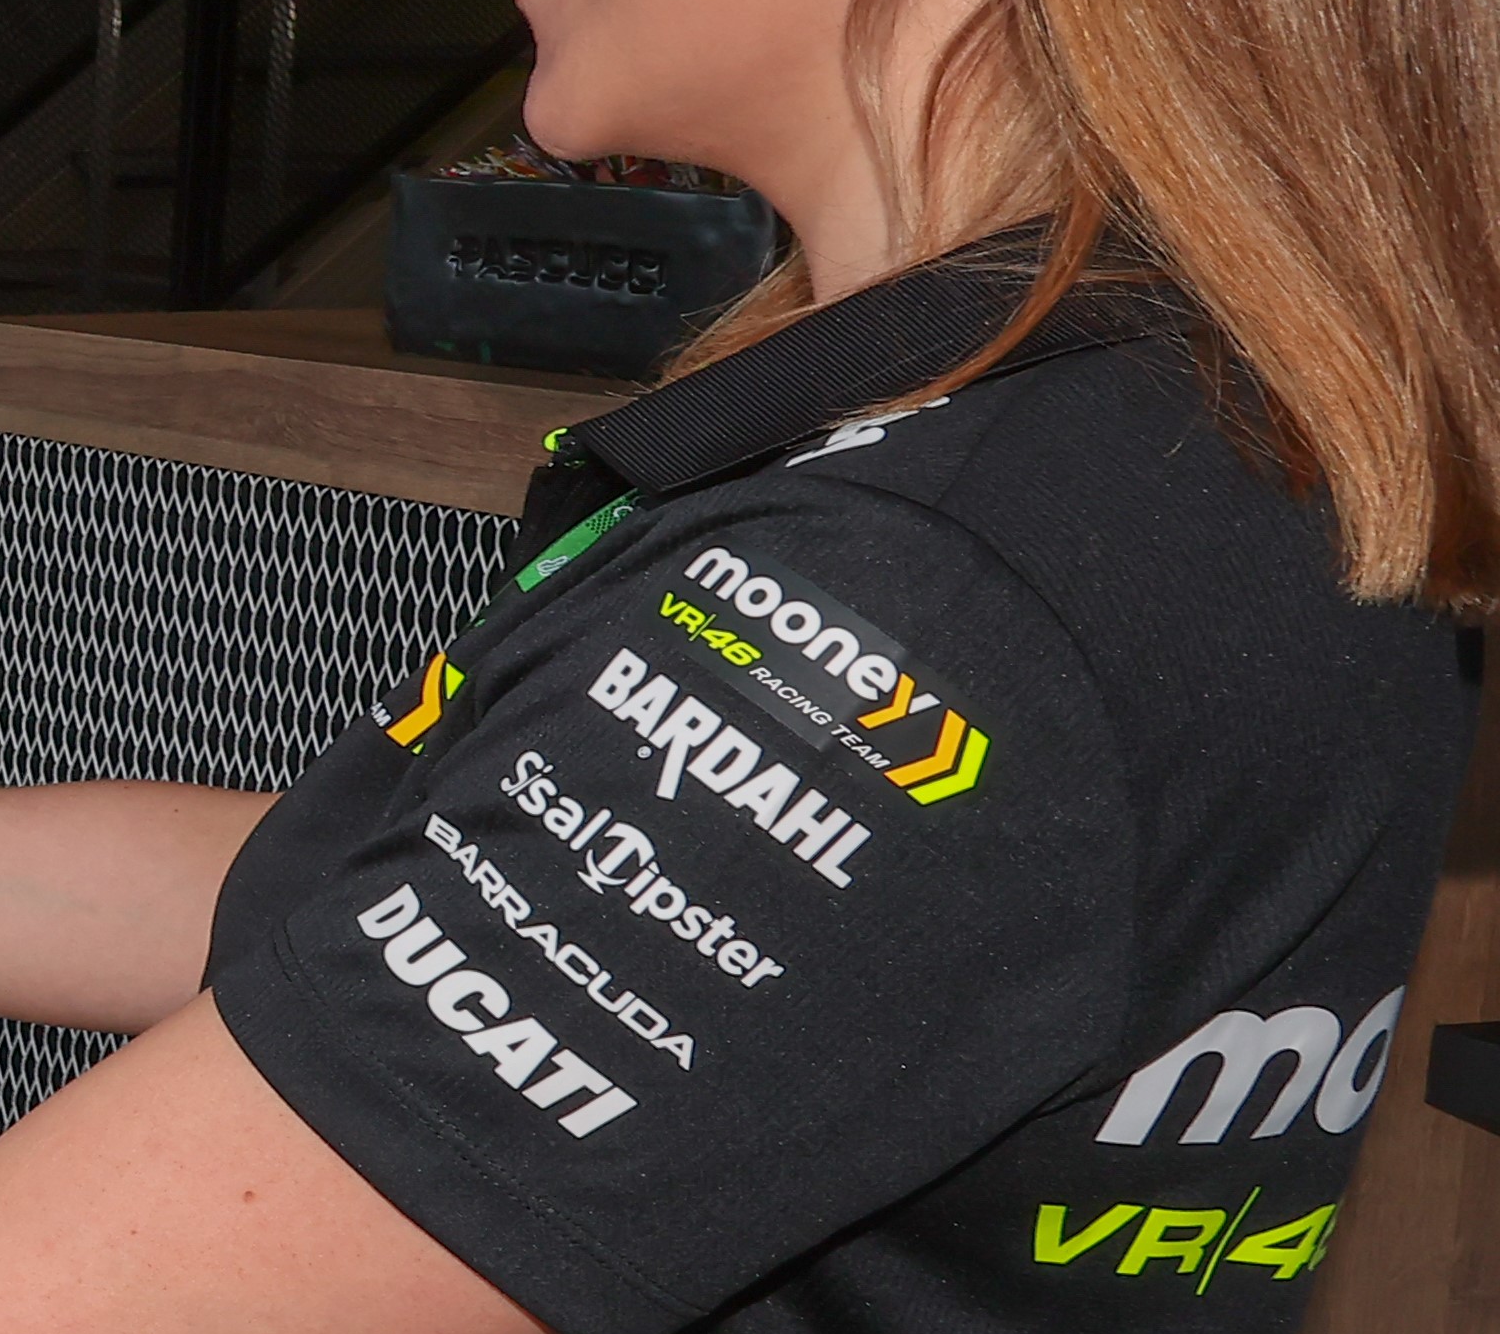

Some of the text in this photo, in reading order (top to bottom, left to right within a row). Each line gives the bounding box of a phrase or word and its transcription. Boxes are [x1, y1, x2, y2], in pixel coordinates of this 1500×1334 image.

[683, 546, 941, 730] mooney
[749, 666, 833, 727] RACING
[830, 723, 892, 771] TEAM
[587, 647, 873, 890] BARDAHL
[356, 882, 639, 1139] DUCATI
[423, 812, 696, 1072] BARRACUDA
